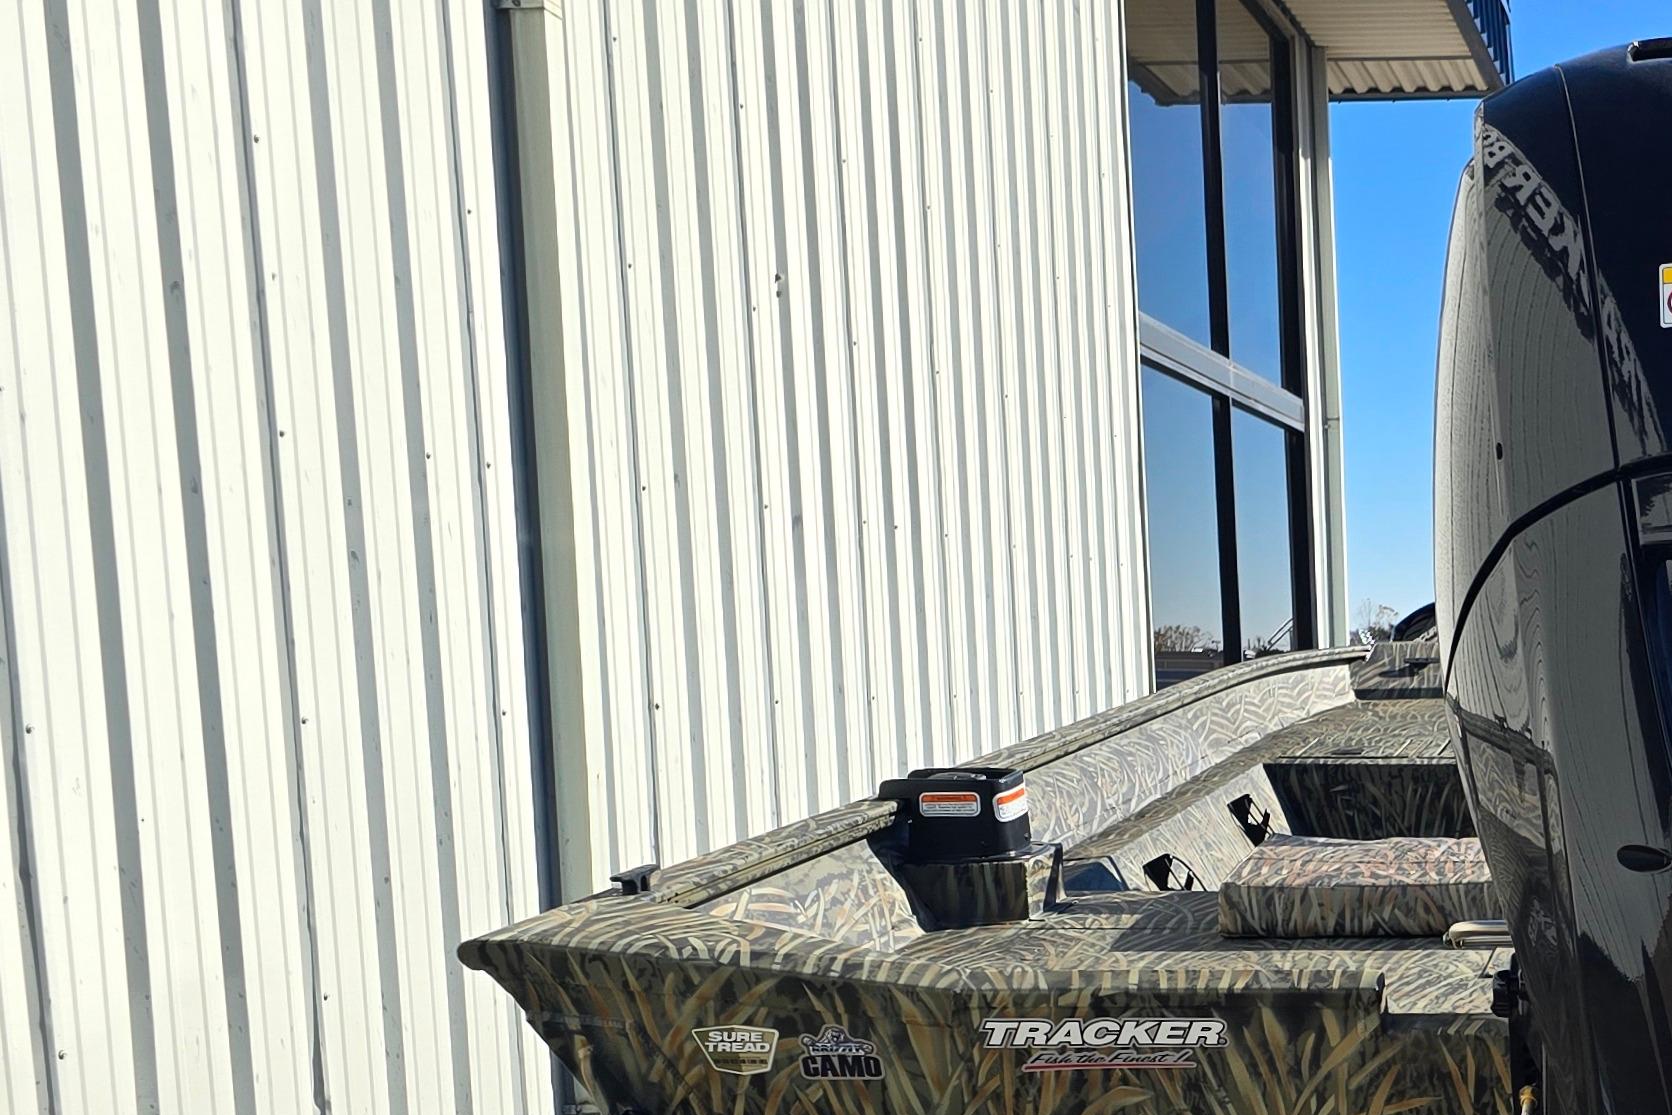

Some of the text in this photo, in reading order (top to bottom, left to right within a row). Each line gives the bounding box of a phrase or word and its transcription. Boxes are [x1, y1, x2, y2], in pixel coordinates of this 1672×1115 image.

[708, 1031, 764, 1043] SURE
[983, 1019, 1228, 1047] TRACKER
[704, 1042, 771, 1053] TREAD
[1030, 1052, 1072, 1064] Fish
[1075, 1051, 1106, 1064] the
[802, 1055, 883, 1078] CAMO
